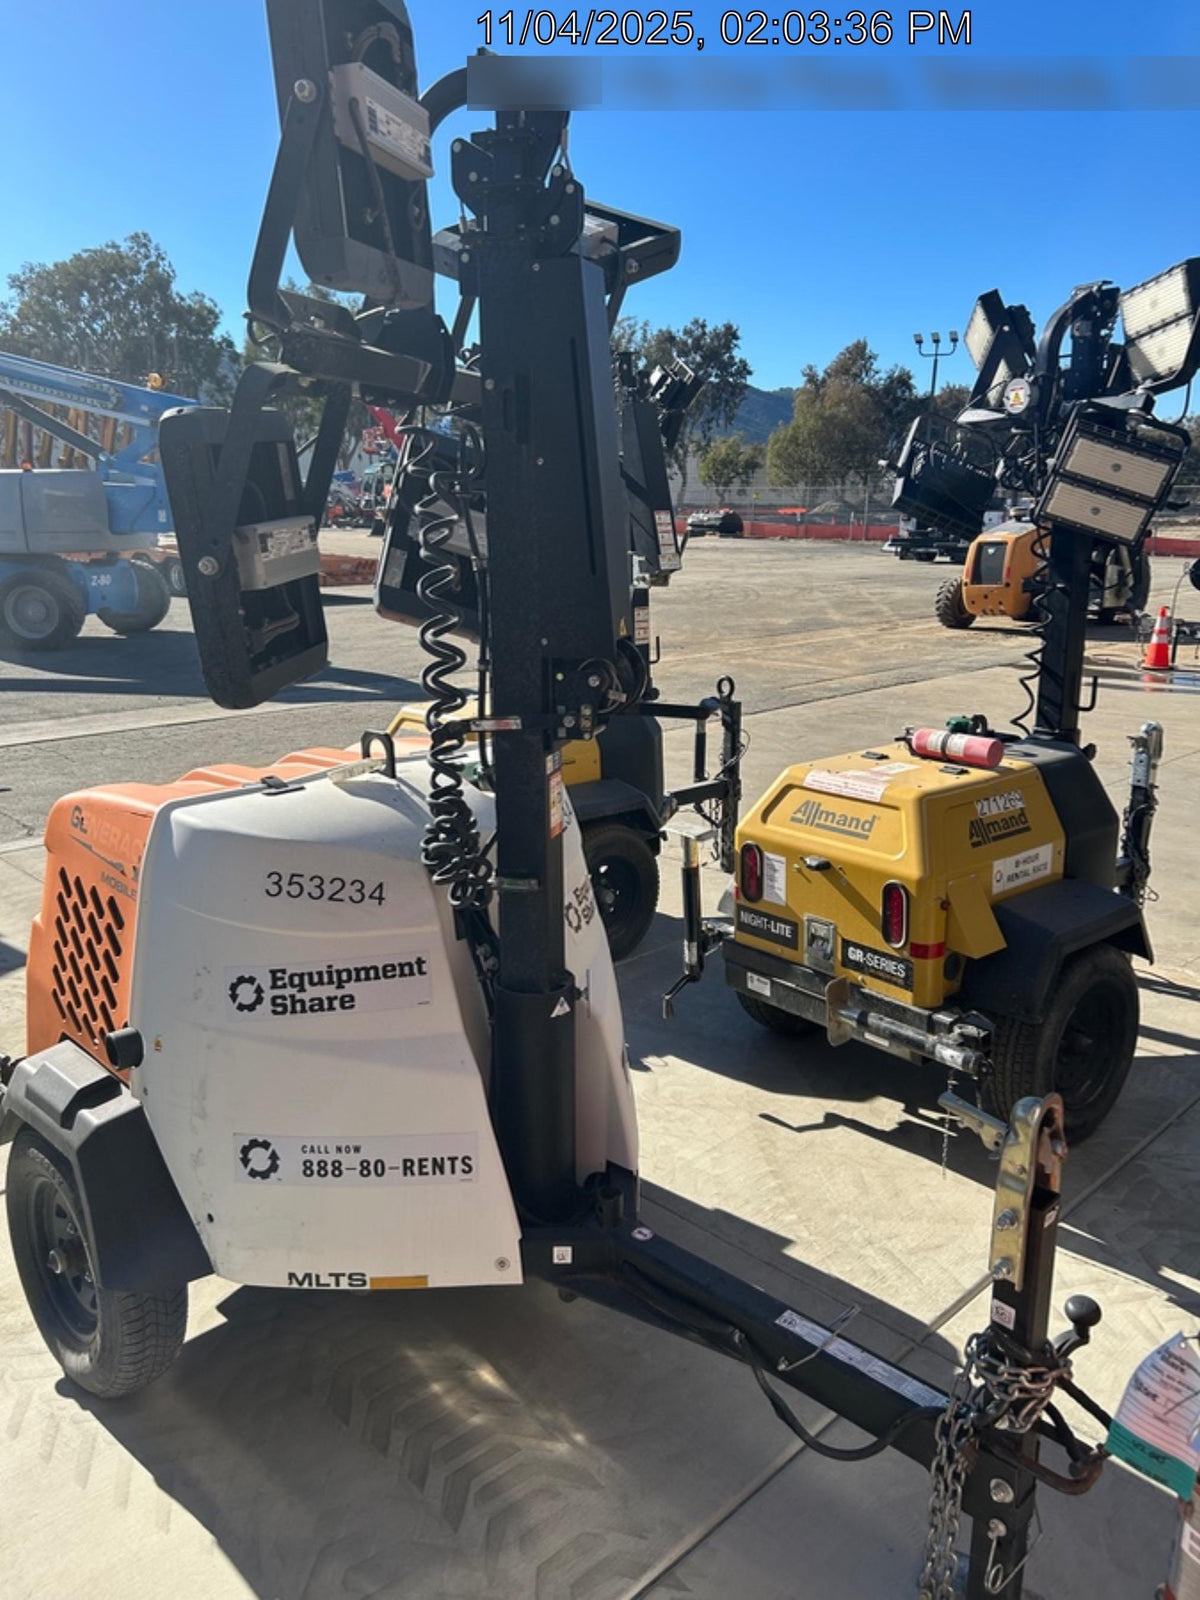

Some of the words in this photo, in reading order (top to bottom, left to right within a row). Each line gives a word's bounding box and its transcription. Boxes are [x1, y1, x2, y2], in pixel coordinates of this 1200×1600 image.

[791, 799, 877, 838] Allmand
[968, 807, 1030, 847] Allmand
[265, 871, 386, 906] 353234
[740, 911, 793, 938] NIGHT-LITE
[269, 956, 427, 992] Equipment
[847, 946, 906, 979] GR-SERIES
[271, 993, 356, 1016] Share
[301, 1144, 330, 1155] CALL
[335, 1144, 362, 1155] NOW
[302, 1155, 474, 1178] 888-80-RENTS
[287, 1271, 368, 1288] MLTS
